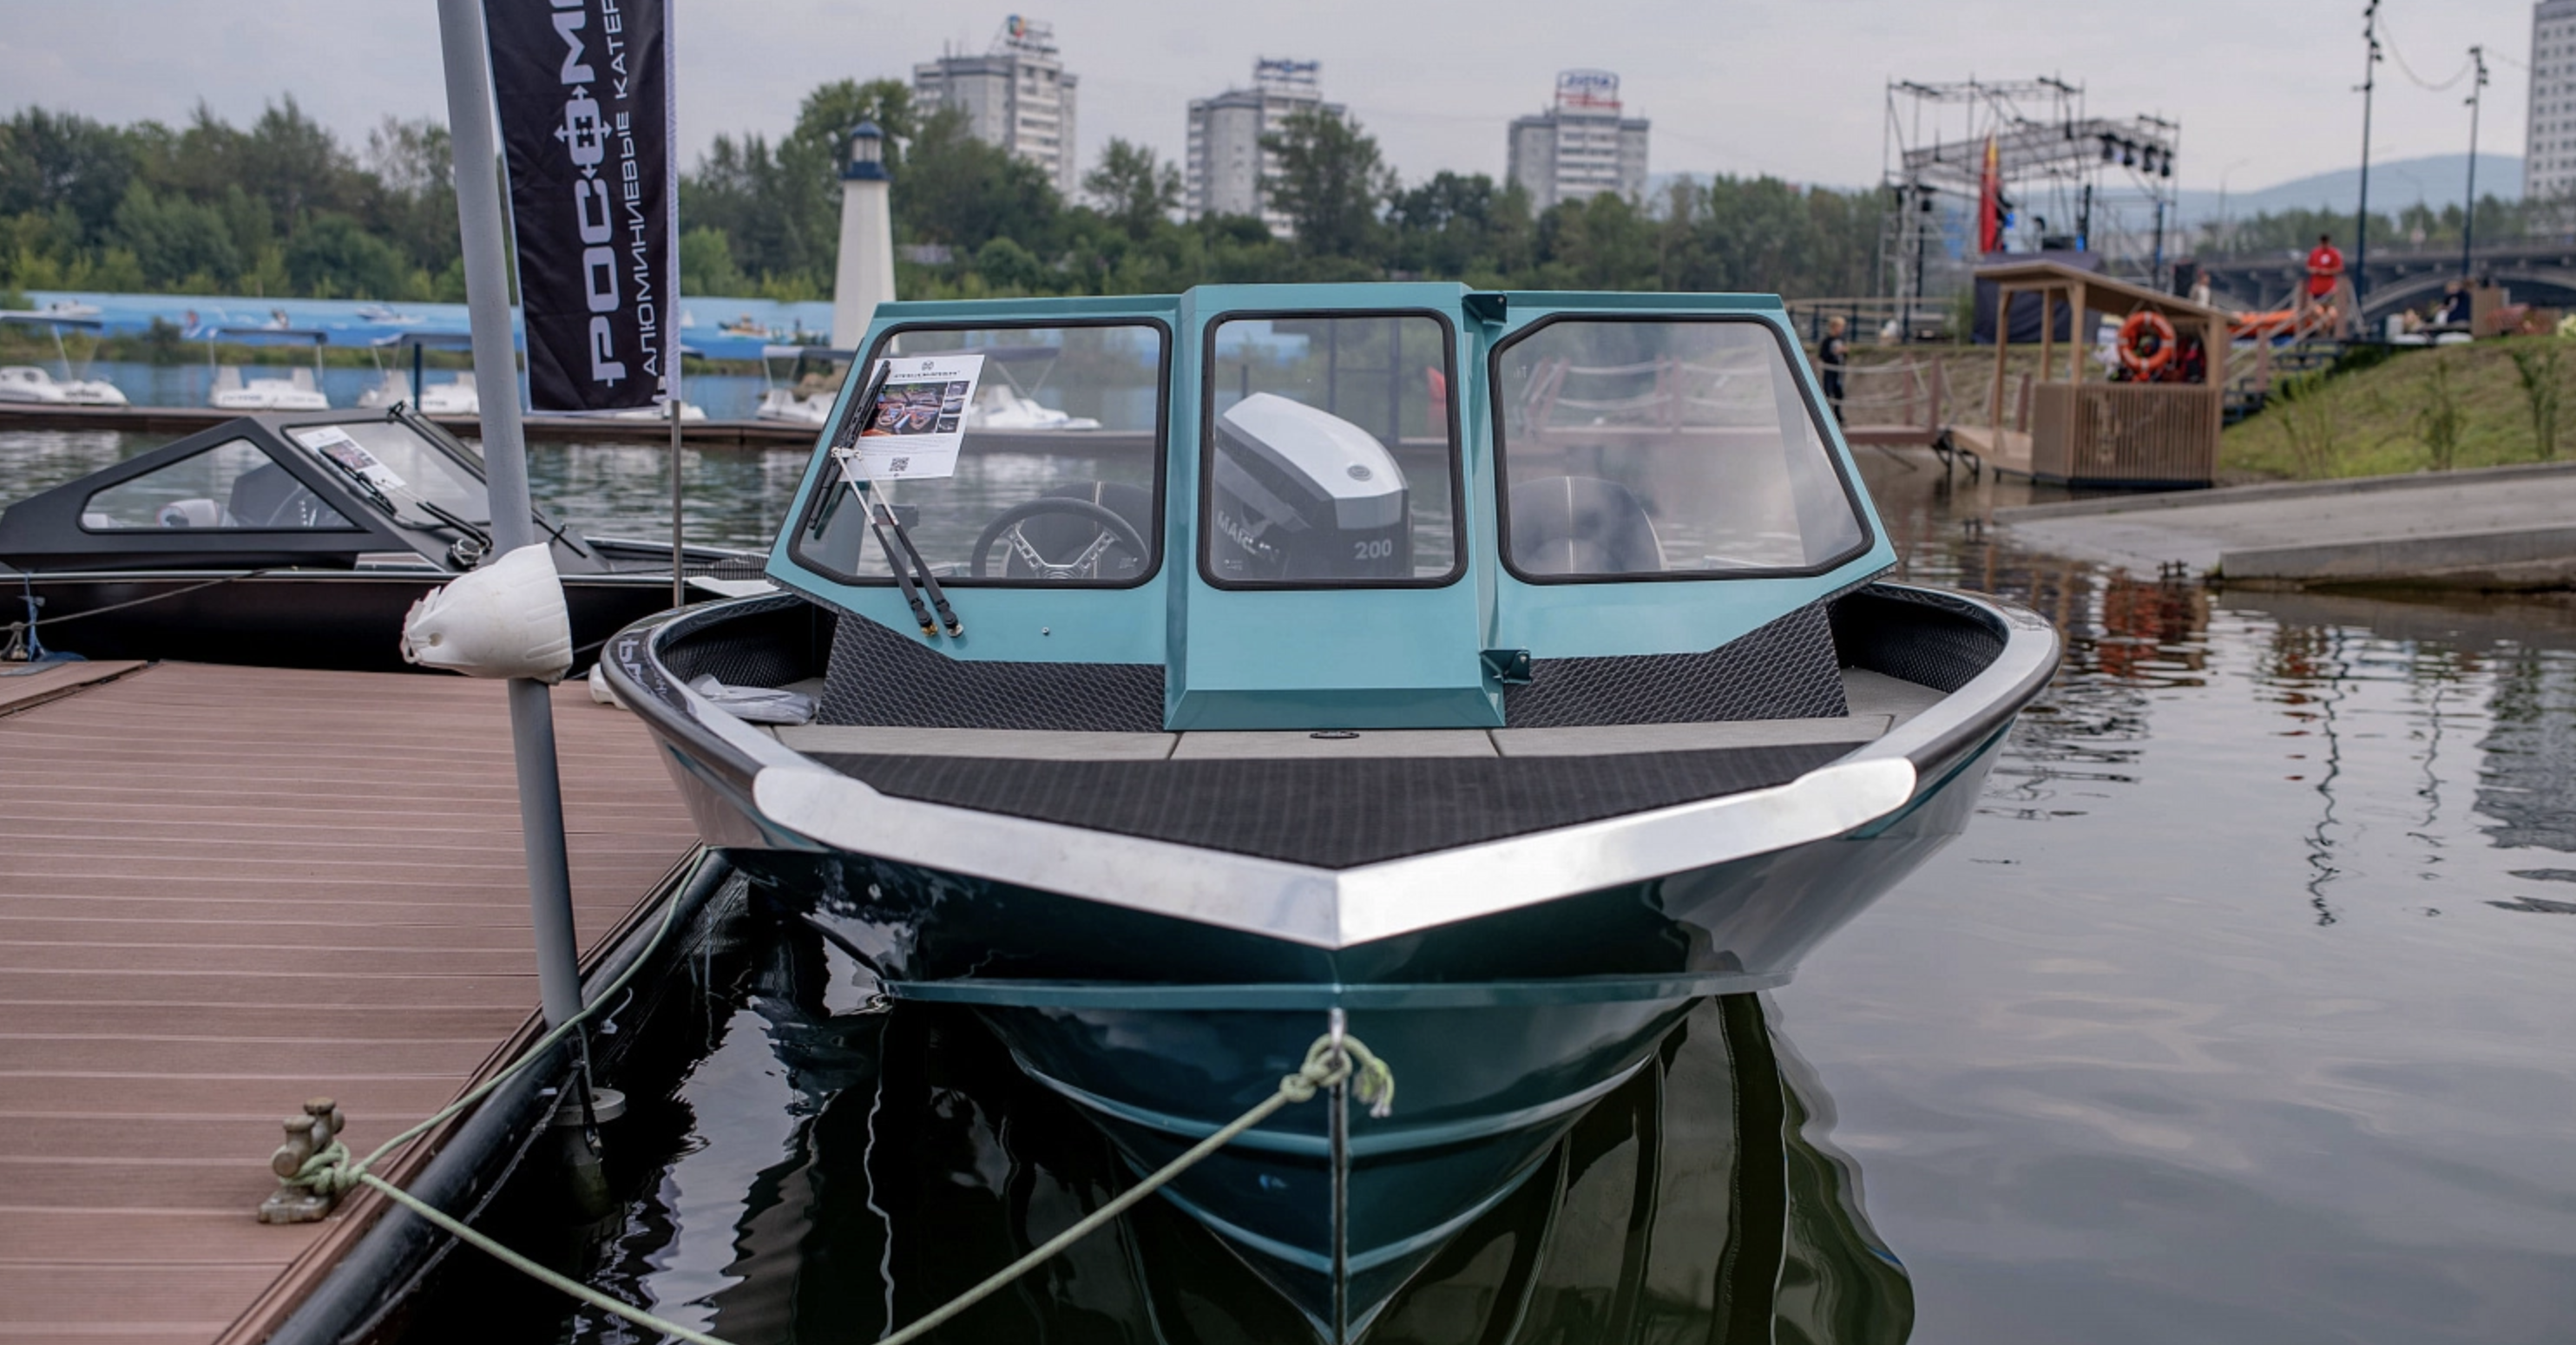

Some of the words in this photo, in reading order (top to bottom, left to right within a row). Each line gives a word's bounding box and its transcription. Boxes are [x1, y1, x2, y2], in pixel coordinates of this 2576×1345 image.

[549, 0, 626, 387] РОСОМ
[615, 111, 658, 377] АЛЮМИНИЕВЫЕ
[1354, 539, 1393, 560] 200
